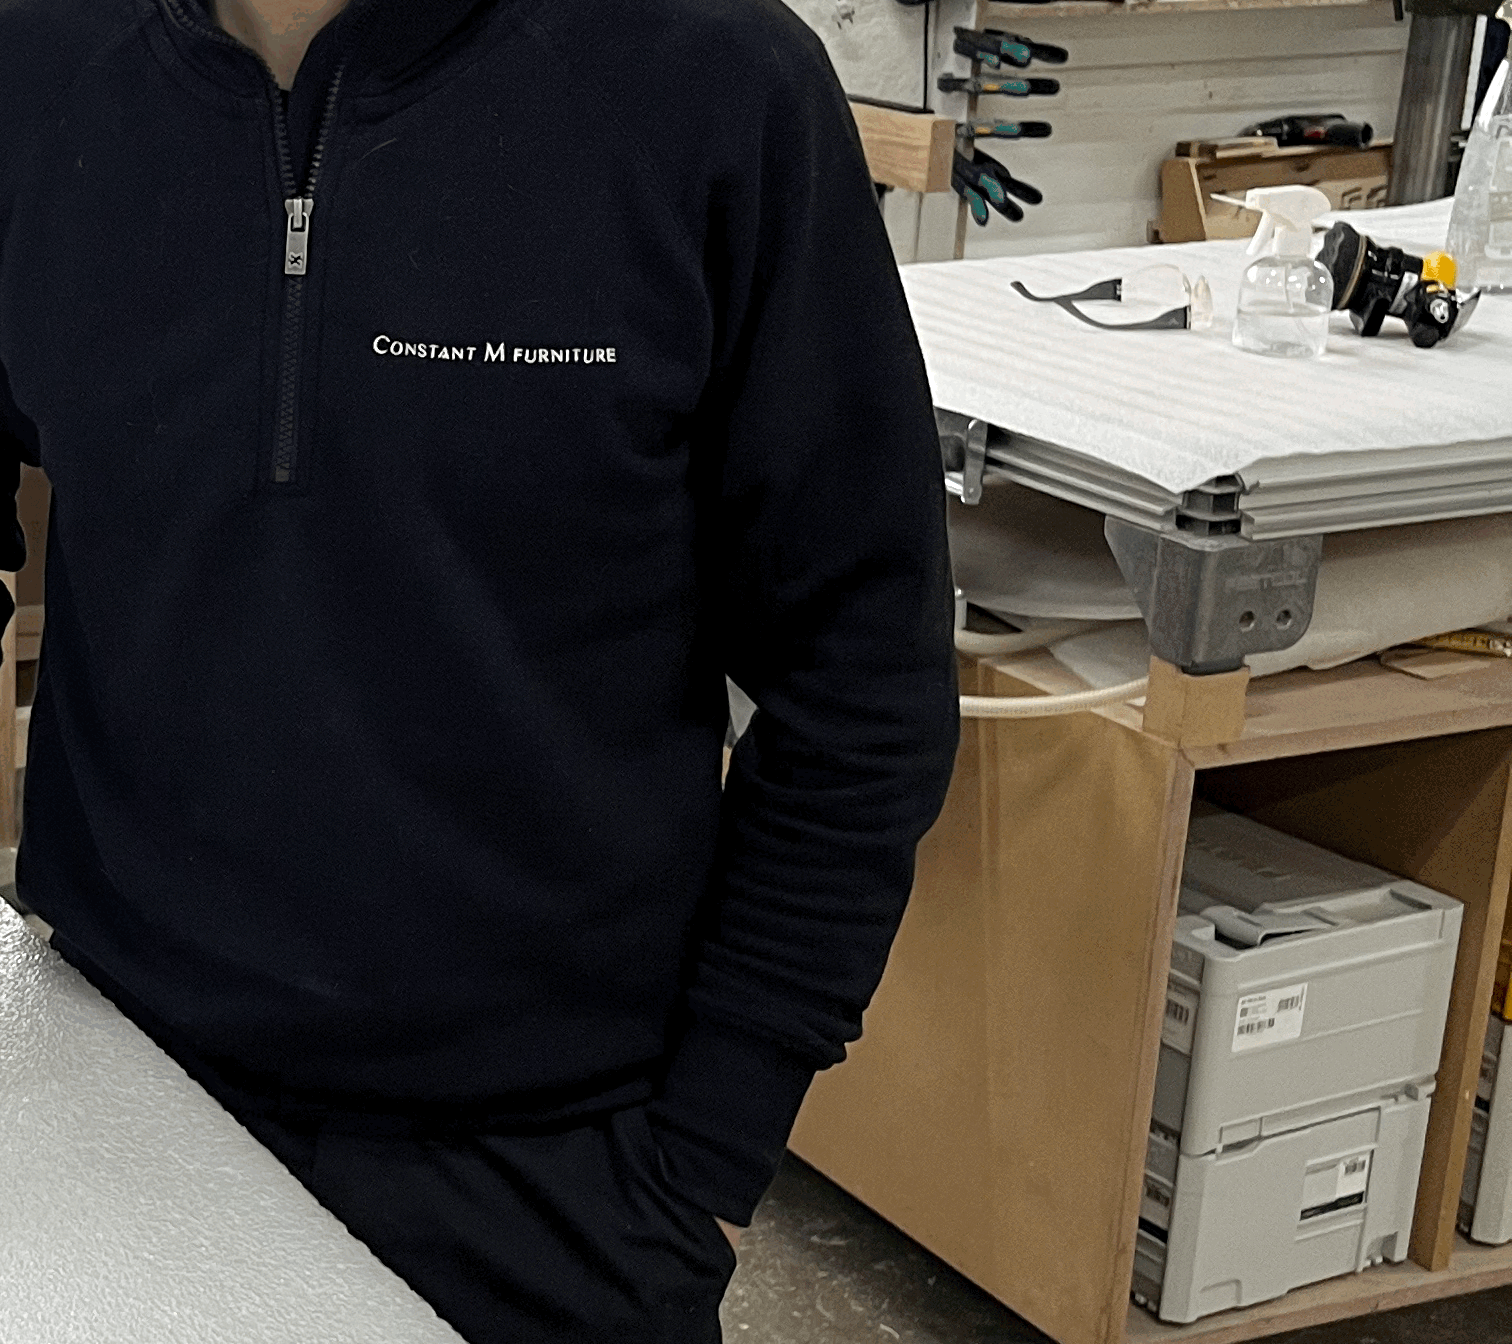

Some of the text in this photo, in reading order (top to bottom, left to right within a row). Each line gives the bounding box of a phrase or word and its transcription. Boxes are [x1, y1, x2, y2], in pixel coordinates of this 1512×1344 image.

[373, 334, 617, 364] CONSTANT M FURNITURE
